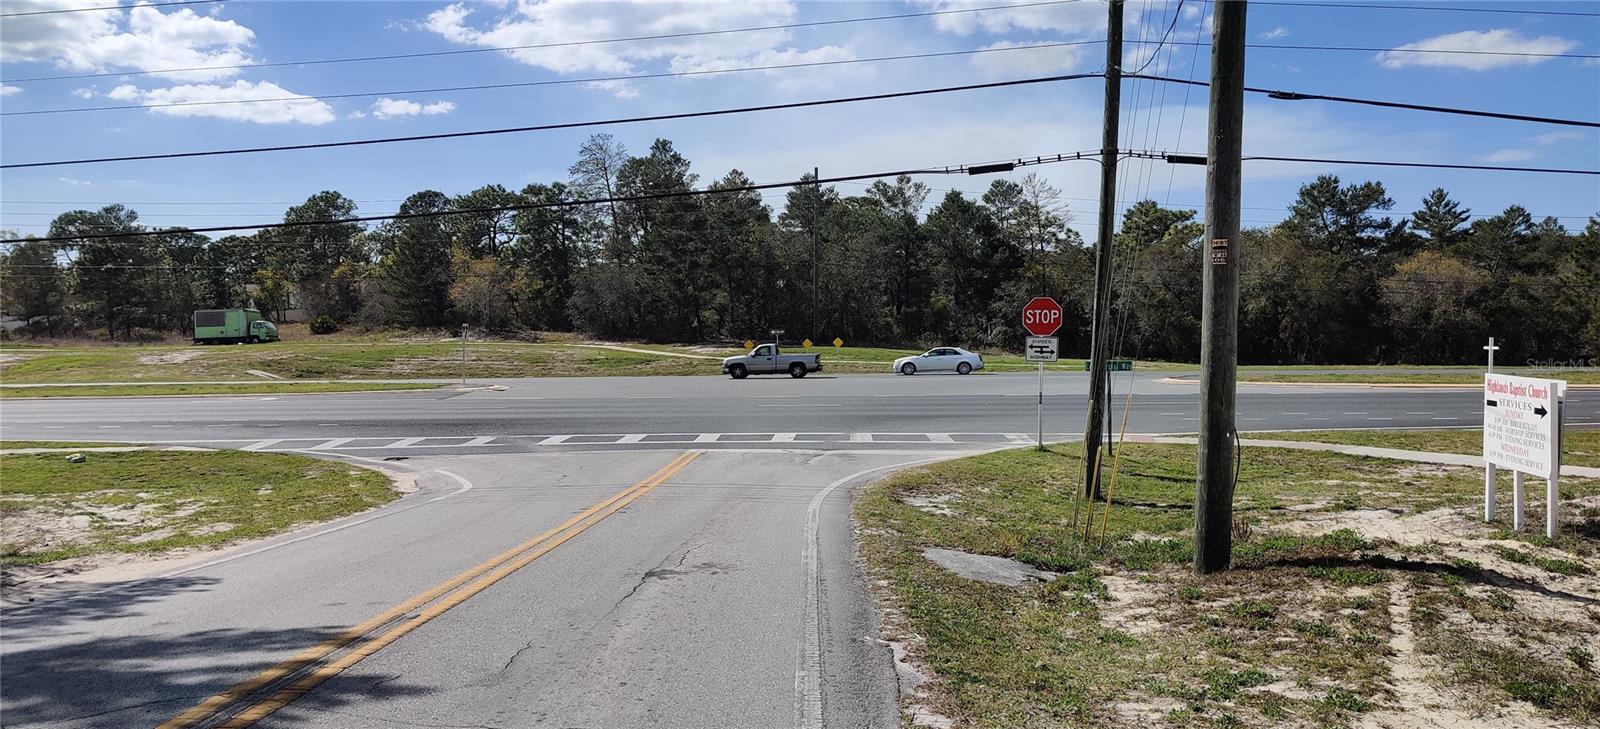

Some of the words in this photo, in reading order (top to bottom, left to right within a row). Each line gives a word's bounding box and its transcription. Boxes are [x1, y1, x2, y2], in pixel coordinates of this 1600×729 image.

[1026, 310, 1059, 324] STOP
[1488, 379, 1508, 394] Highlands
[1510, 382, 1527, 398] Baptist
[1528, 384, 1548, 401] Church
[1498, 399, 1533, 412] SERVICES
[1504, 409, 1524, 420] SUNDAY
[1525, 430, 1547, 442] SERVICES
[1501, 443, 1530, 457] WEDNESDAY
[1523, 438, 1545, 450] SERVICES
[1524, 458, 1544, 470] SERVICE
